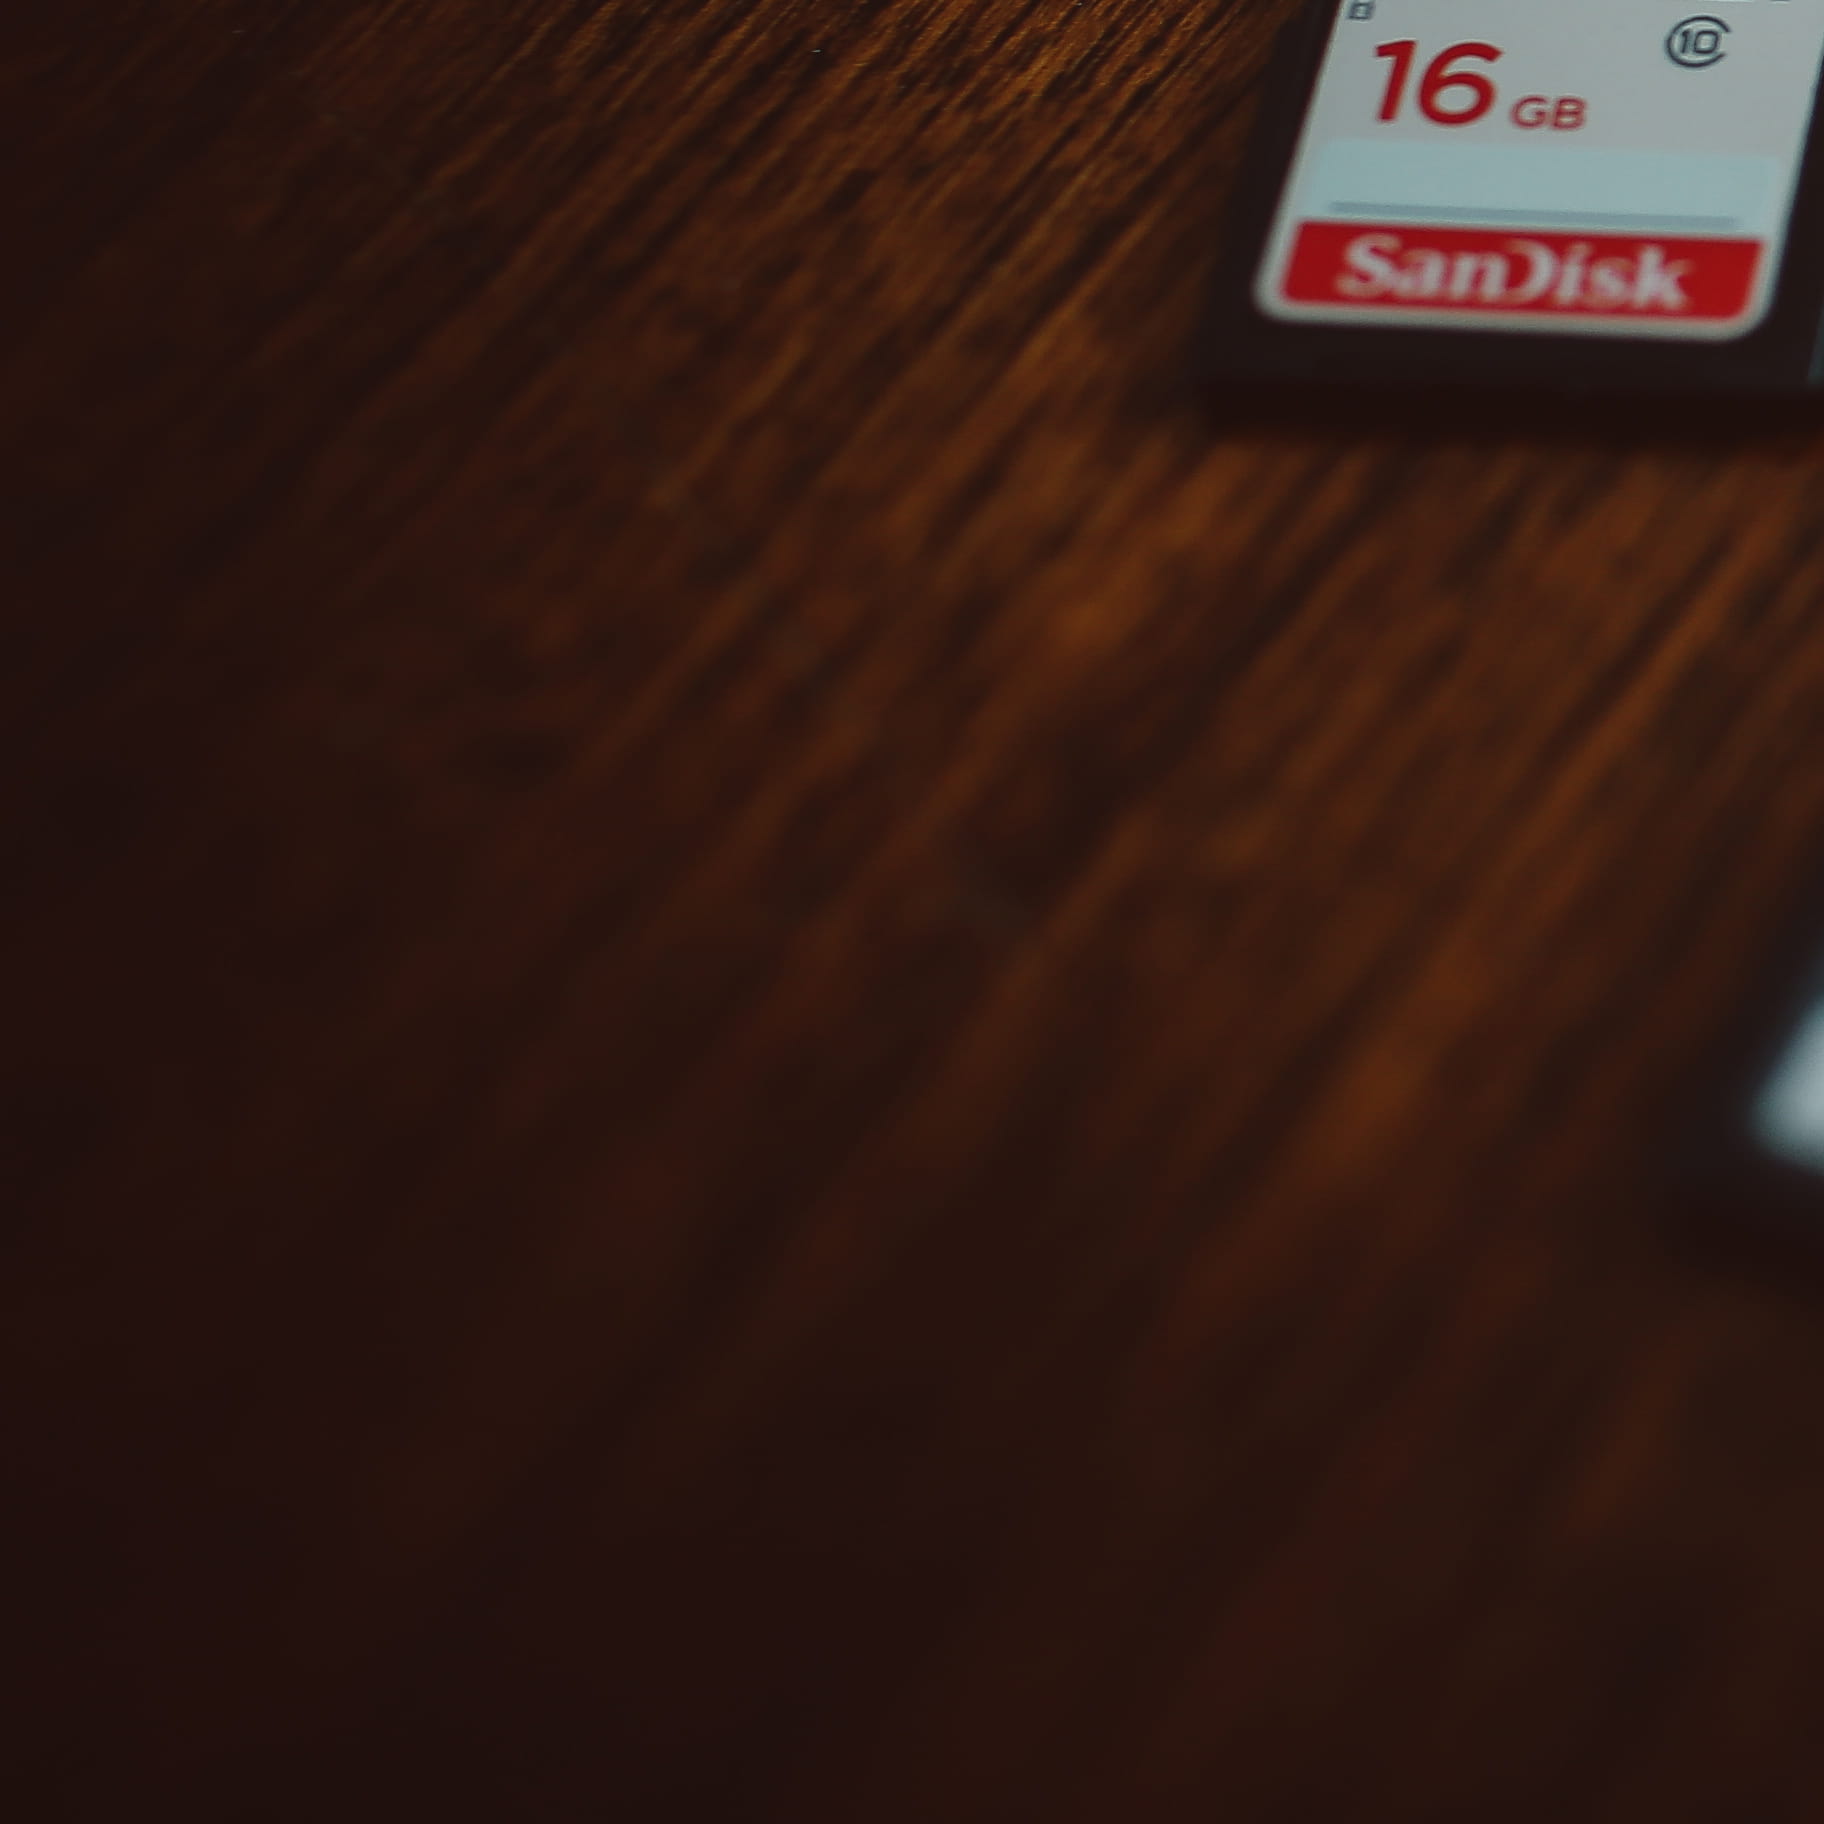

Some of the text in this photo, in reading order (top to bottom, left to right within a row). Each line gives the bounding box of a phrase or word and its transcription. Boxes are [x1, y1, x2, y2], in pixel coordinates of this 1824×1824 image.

[1374, 39, 1588, 132] 16 GB
[1336, 232, 1696, 311] SanDisk
